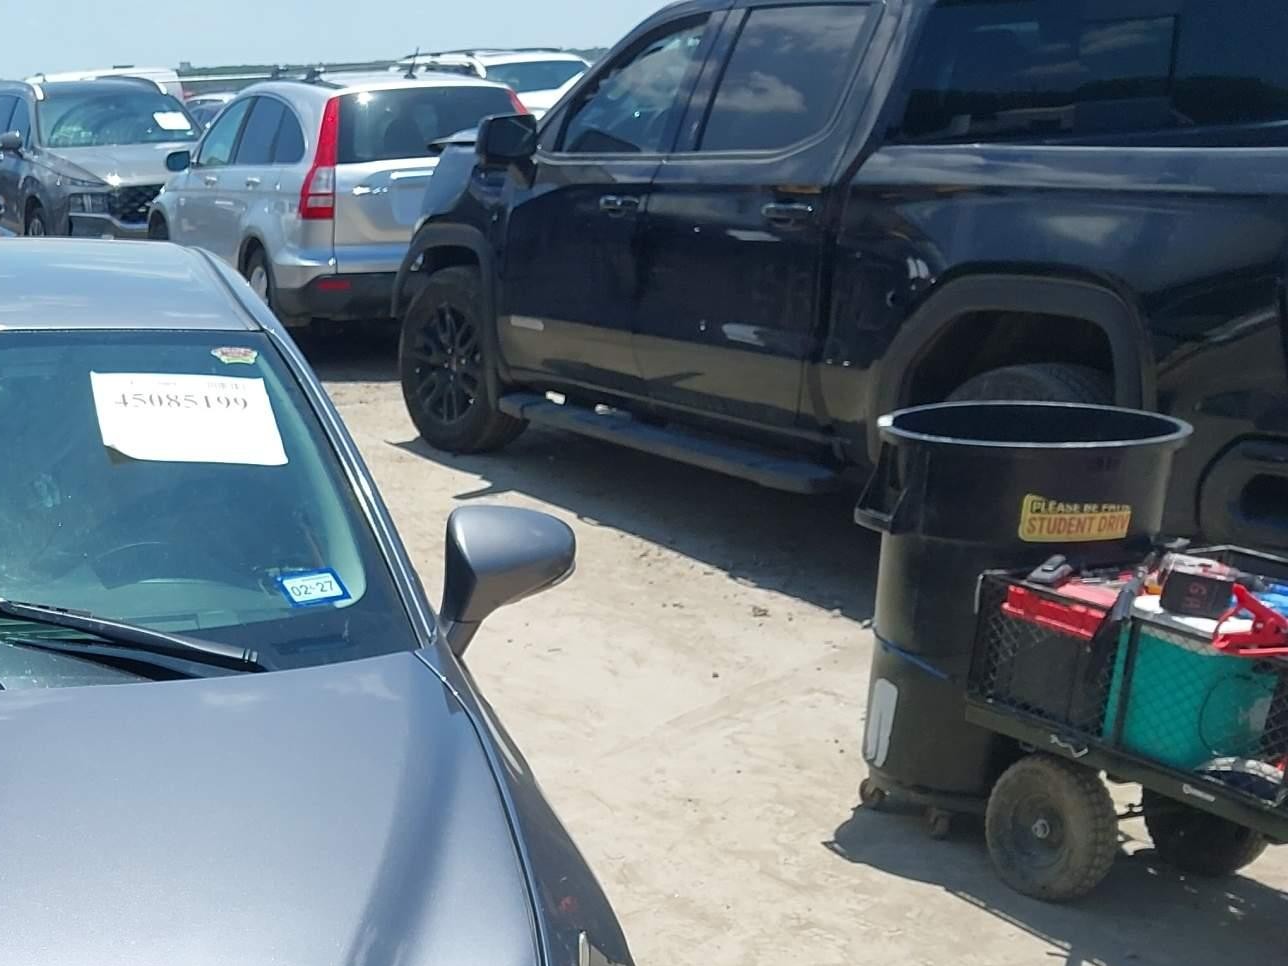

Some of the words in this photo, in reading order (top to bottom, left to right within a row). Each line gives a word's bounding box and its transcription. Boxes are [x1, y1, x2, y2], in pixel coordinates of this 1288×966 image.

[115, 392, 248, 411] 45085199
[1031, 499, 1081, 514] PLEASE
[1026, 514, 1096, 535] STUDENT
